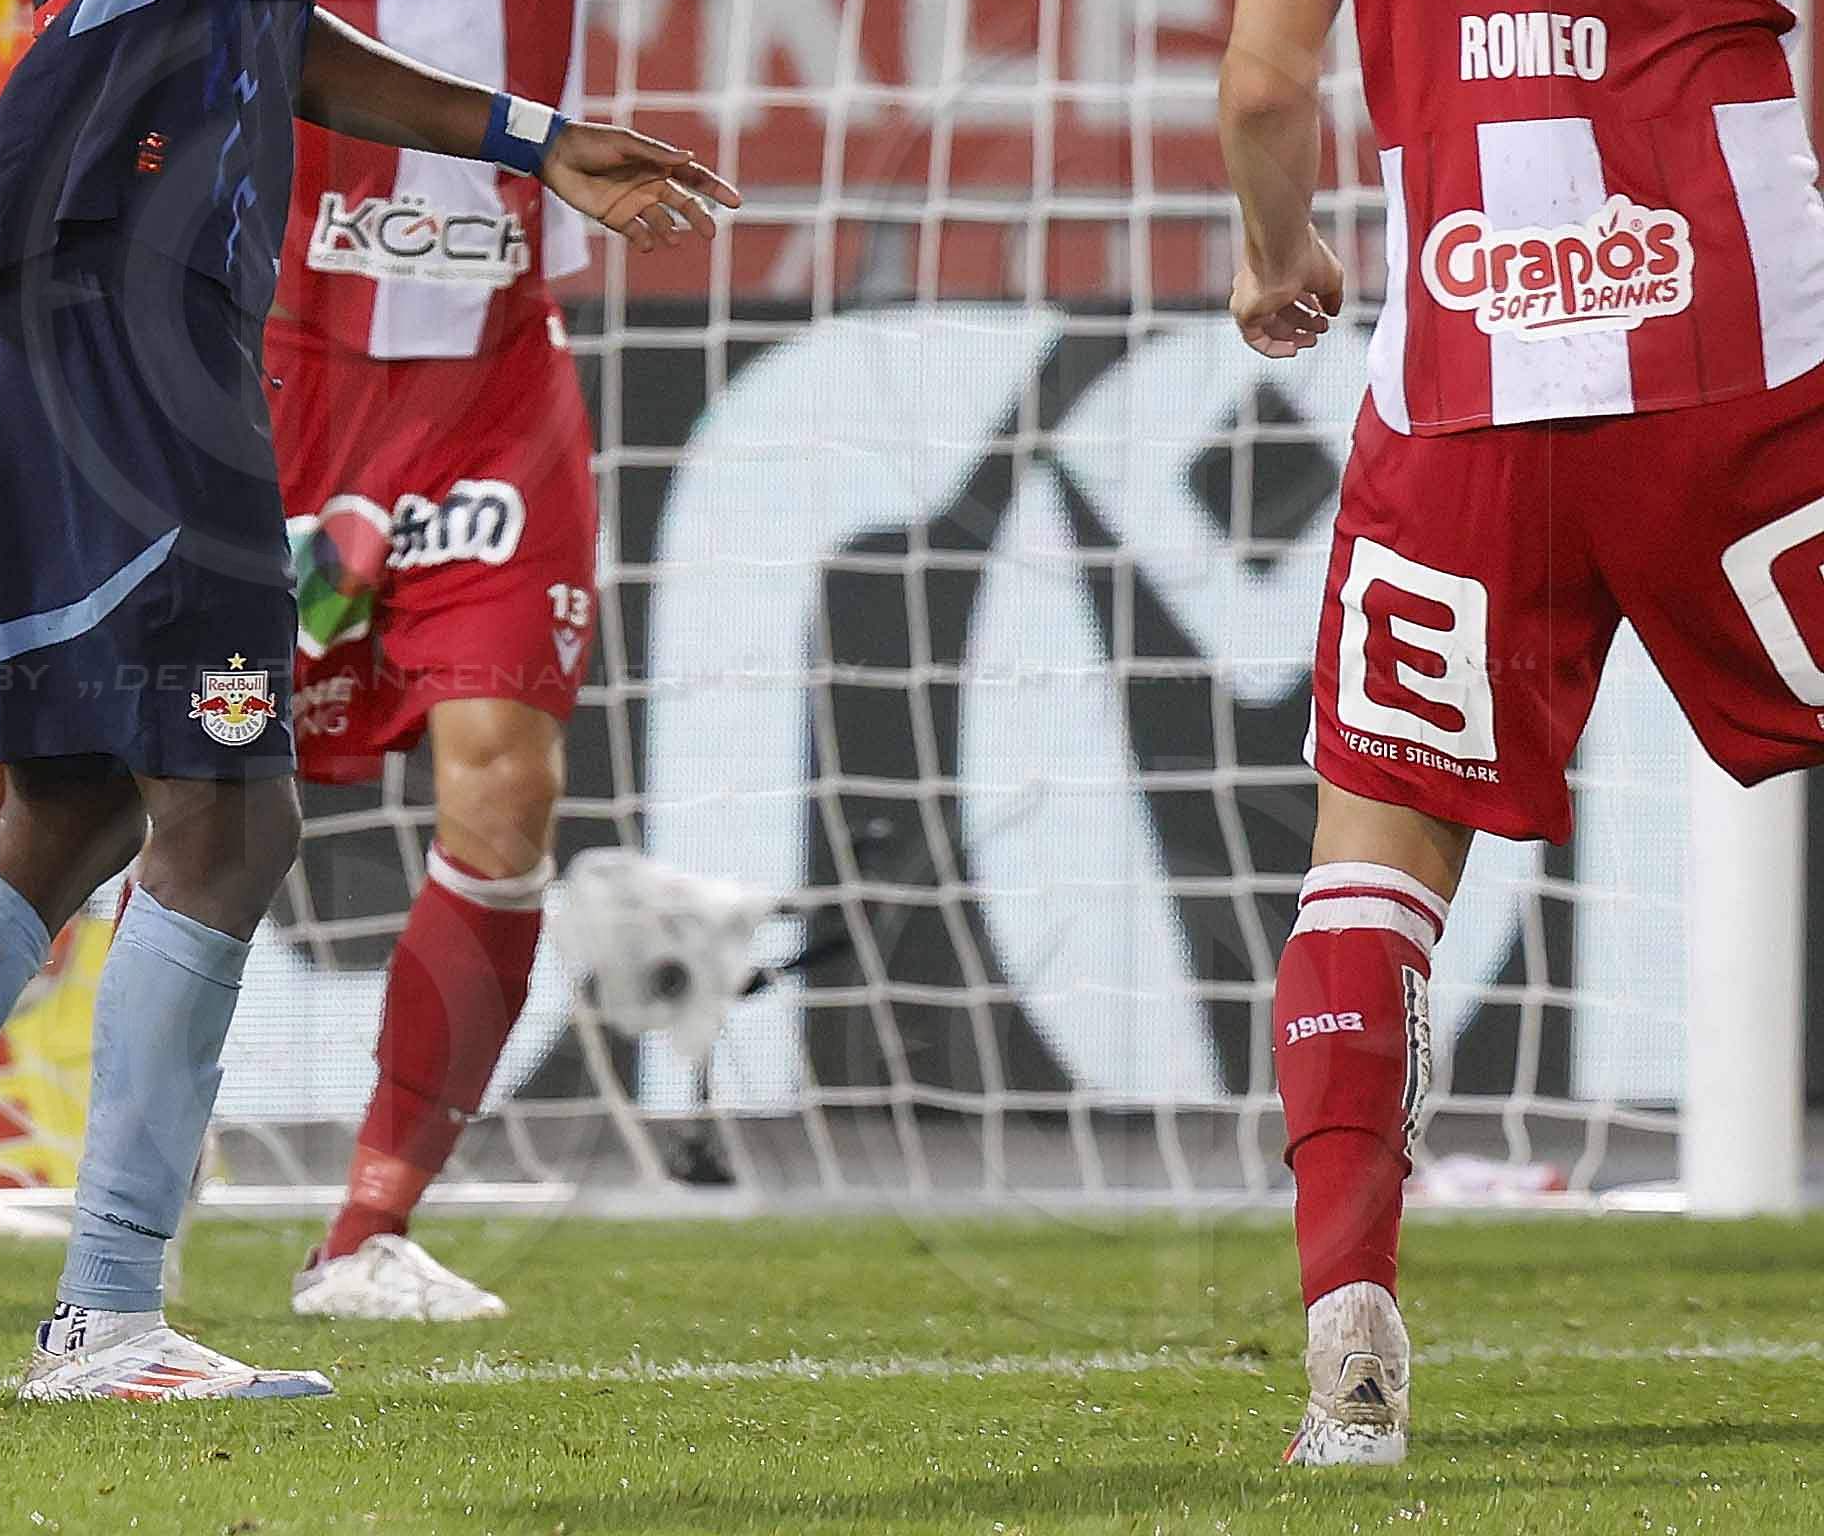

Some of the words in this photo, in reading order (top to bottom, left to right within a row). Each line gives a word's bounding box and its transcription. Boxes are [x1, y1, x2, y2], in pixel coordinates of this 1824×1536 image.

[1459, 13, 1609, 81] ROMEO
[1488, 291, 1557, 322] SOFT
[1581, 278, 1679, 313] DRINKS
[547, 583, 592, 627] 13
